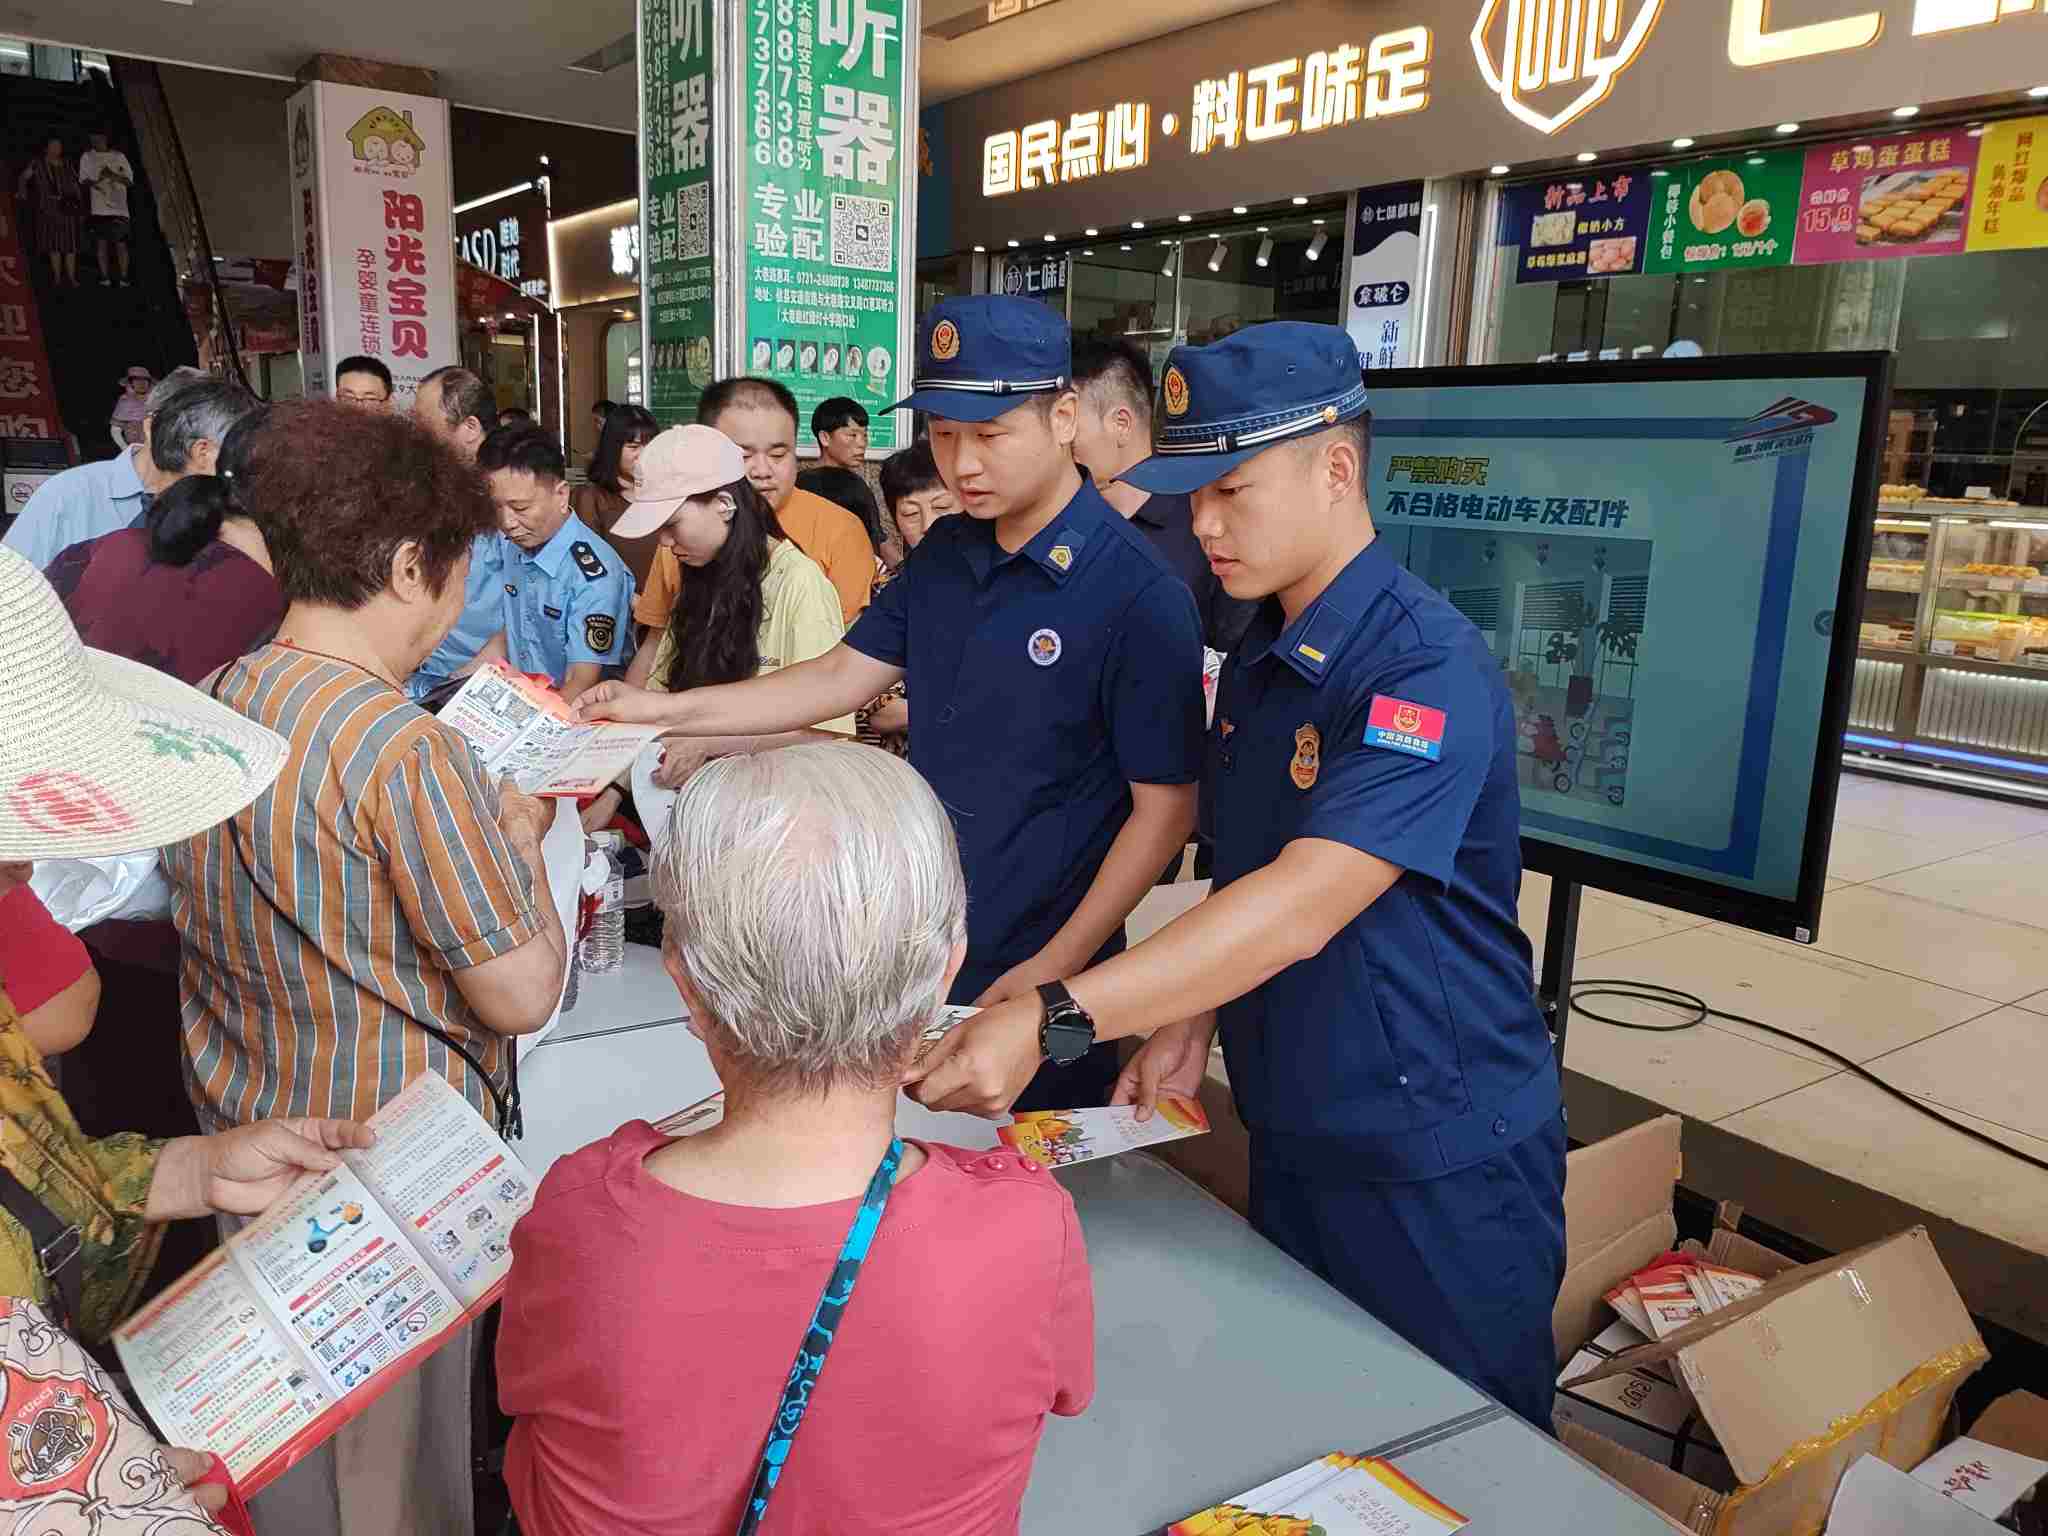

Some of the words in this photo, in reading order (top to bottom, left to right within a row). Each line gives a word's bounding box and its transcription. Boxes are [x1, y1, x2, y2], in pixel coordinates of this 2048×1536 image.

[654, 0, 663, 178] 88738
[815, 0, 897, 186] 听器
[1829, 139, 1952, 173] 草鸡蛋蛋糕
[754, 182, 825, 224] 专业
[1545, 176, 1632, 210] 新品上市
[754, 222, 825, 262] 验配
[384, 190, 428, 359] 阳光宝贝
[357, 248, 381, 356] 孕婴童连锁
[1358, 284, 1404, 305] 拿破仑
[1386, 455, 1489, 487] 严禁购买
[1384, 490, 1630, 529] 不合格电动车及配件
[1377, 730, 1429, 749] 中国消防救援
[18, 1387, 54, 1418] GUCCI
